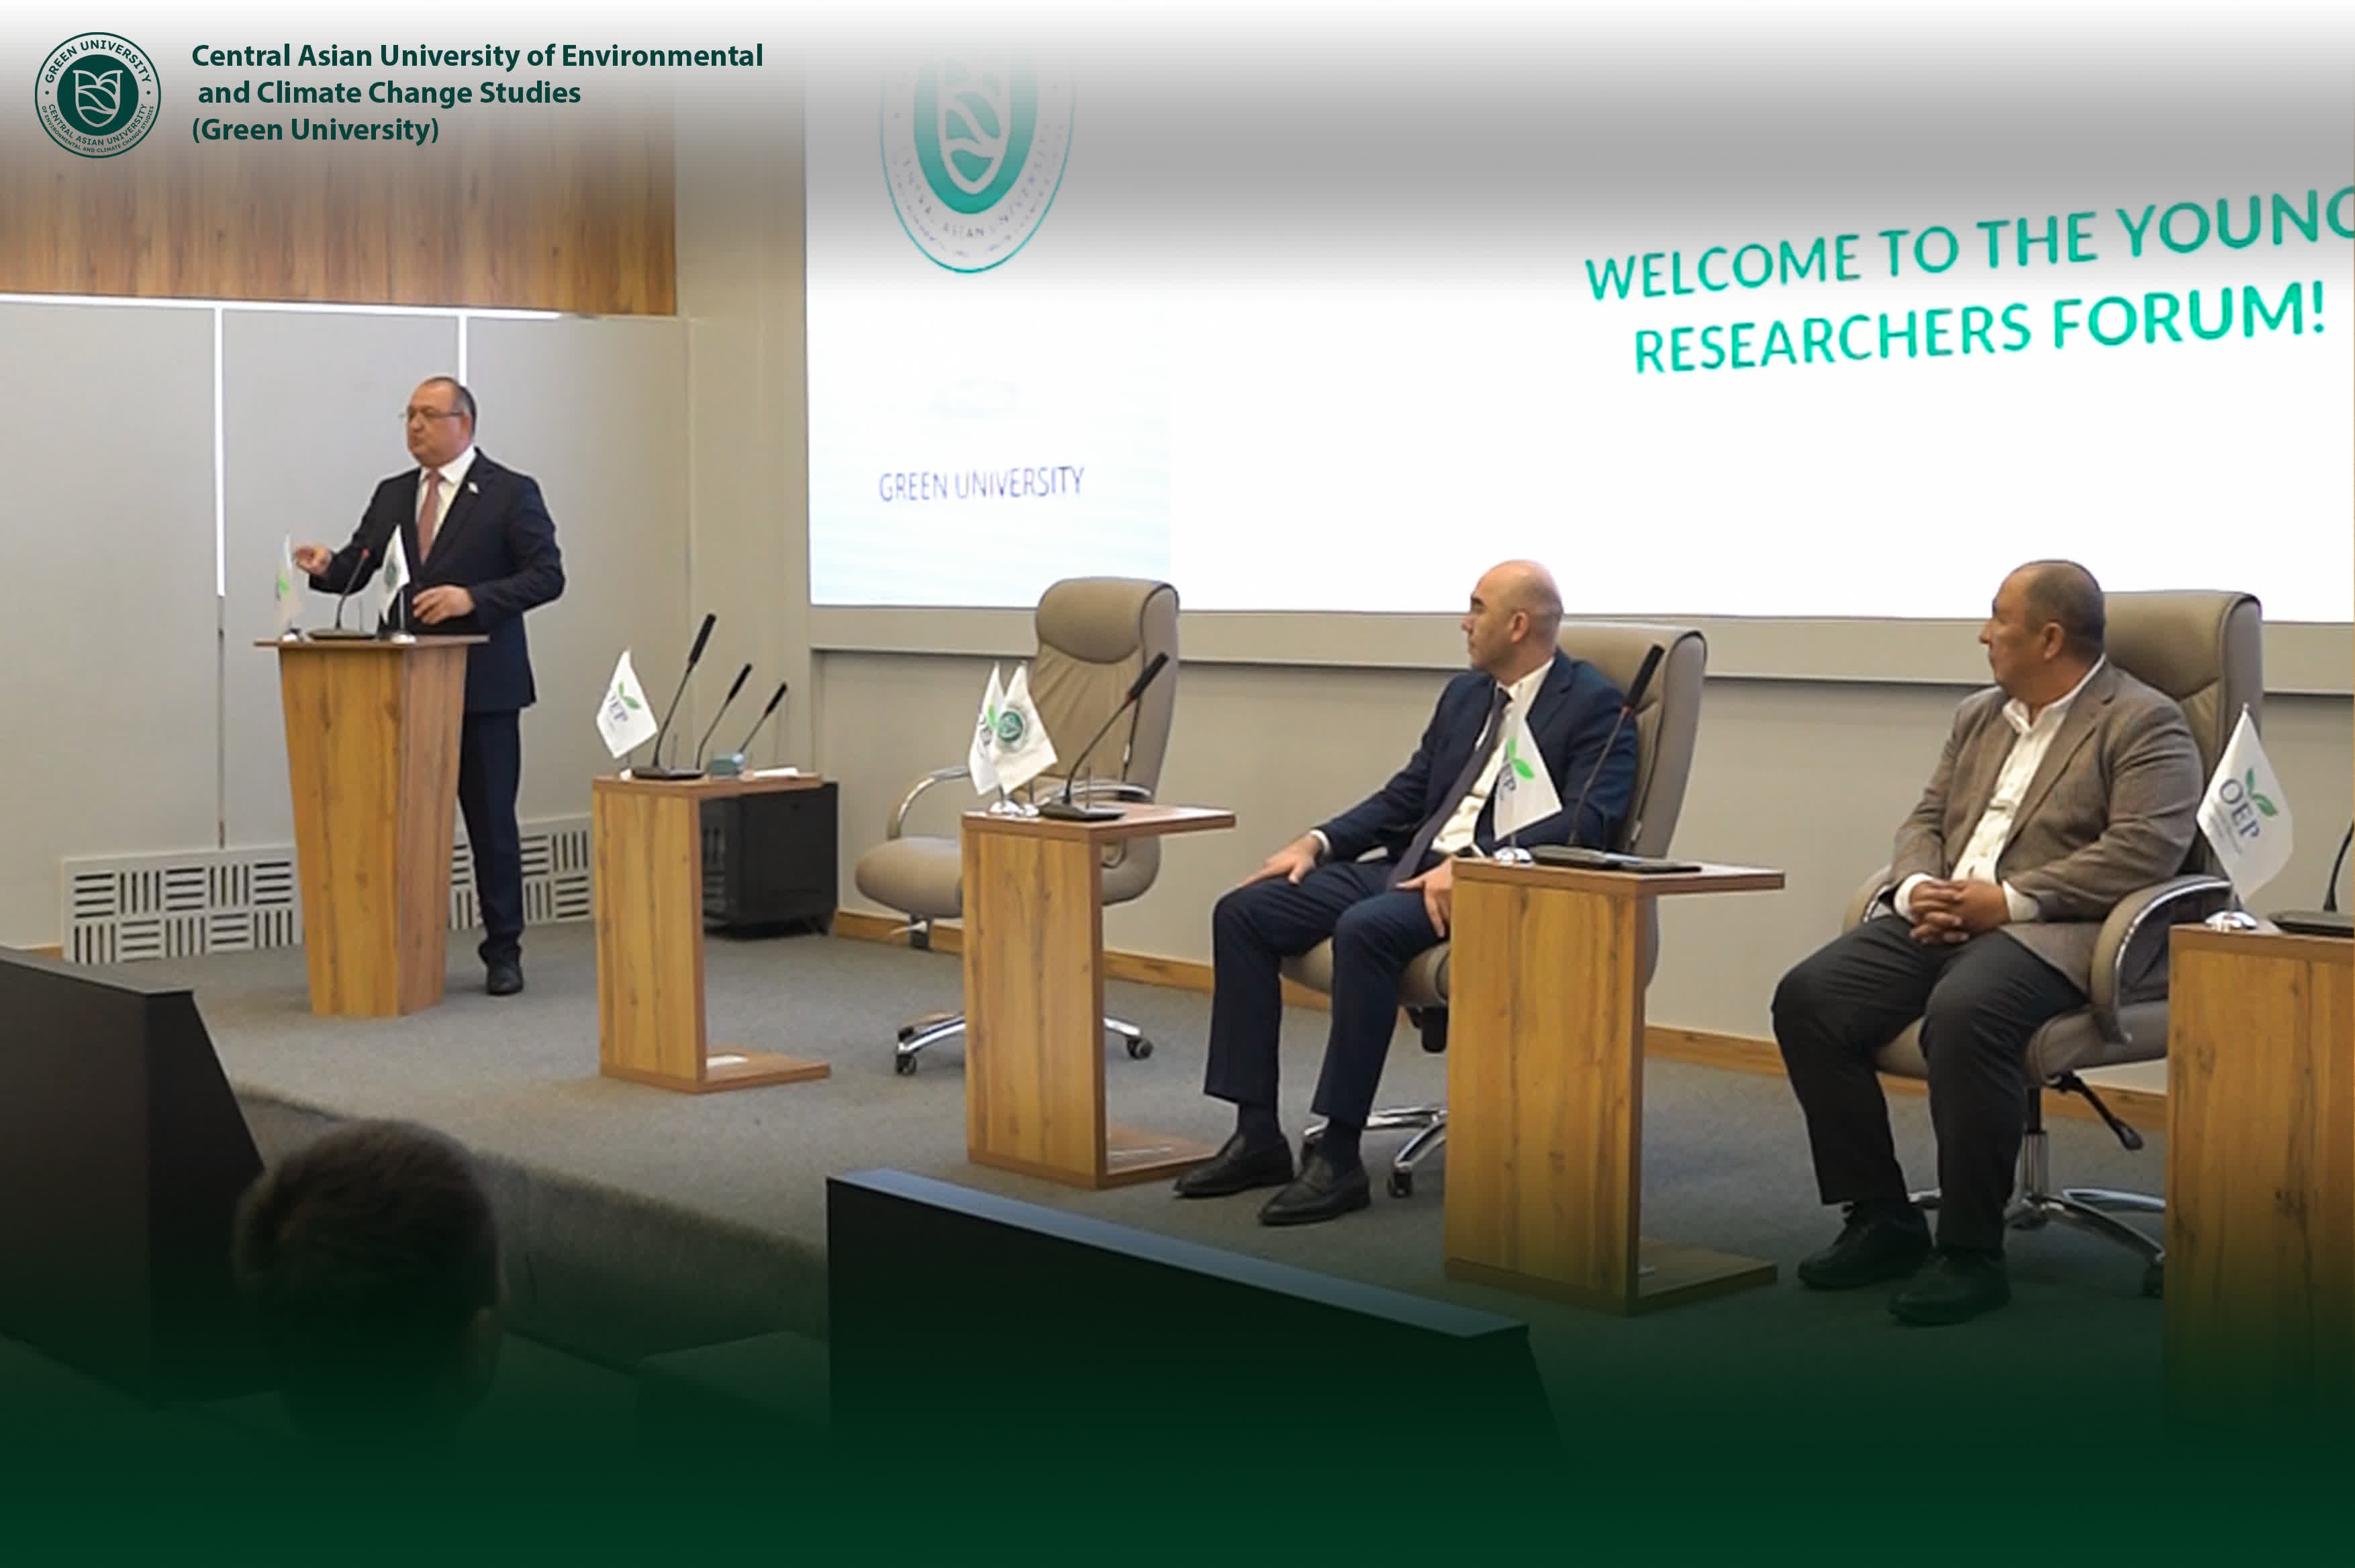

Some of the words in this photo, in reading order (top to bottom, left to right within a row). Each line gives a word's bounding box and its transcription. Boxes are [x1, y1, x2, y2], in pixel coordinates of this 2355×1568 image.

[1584, 234, 1860, 301] WELCOME
[1878, 226, 1960, 277] TO
[1976, 212, 2098, 269] THE
[1635, 303, 2032, 375] RESEARCHERS
[2053, 279, 2325, 350] FORUM!
[879, 471, 948, 502] GREEN
[955, 465, 1084, 499] UNIVERSITY
[2219, 778, 2260, 838] OEP
